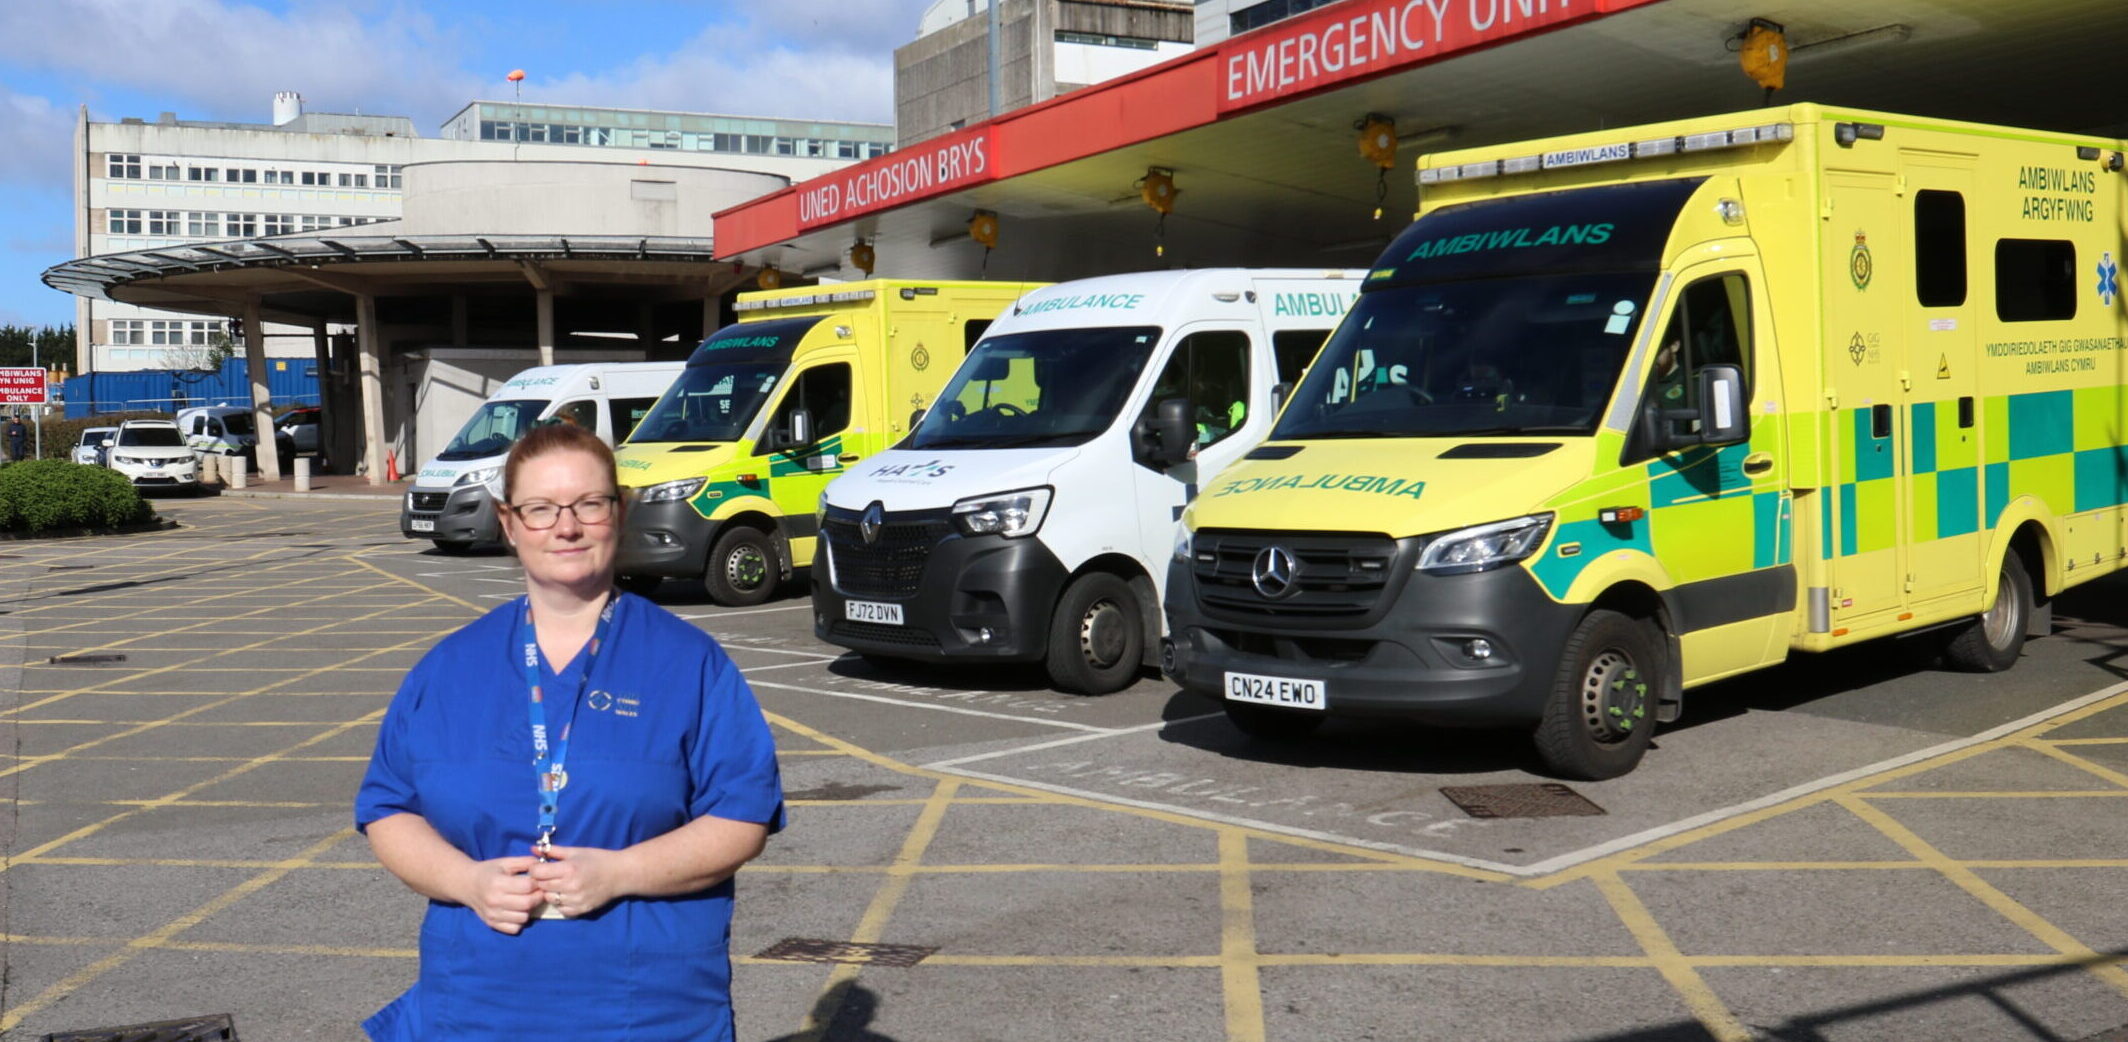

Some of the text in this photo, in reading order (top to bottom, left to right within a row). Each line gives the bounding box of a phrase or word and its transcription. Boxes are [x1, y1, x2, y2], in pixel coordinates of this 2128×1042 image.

[1228, 0, 1449, 100] EMERGENCY
[1546, 144, 1628, 166] AMBIWLANS
[800, 137, 985, 222] UNED ACHOSION BRYS
[2019, 166, 2095, 194] AMBIWLANS
[2022, 196, 2093, 222] ARGYFWNG
[1406, 223, 1615, 262] AMBIWLANS
[1020, 294, 1145, 316] AMBULANCE
[1275, 293, 1358, 316] AMBUL
[707, 335, 780, 350] AMBIWLANS
[2059, 339, 2072, 353] GIG
[2026, 357, 2096, 375] AMBIWLANS CYMRU
[849, 602, 898, 622] FJ72 DVN
[525, 643, 538, 667] NHS
[1232, 676, 1315, 704] CN24 EWO
[532, 725, 548, 750] NHS
